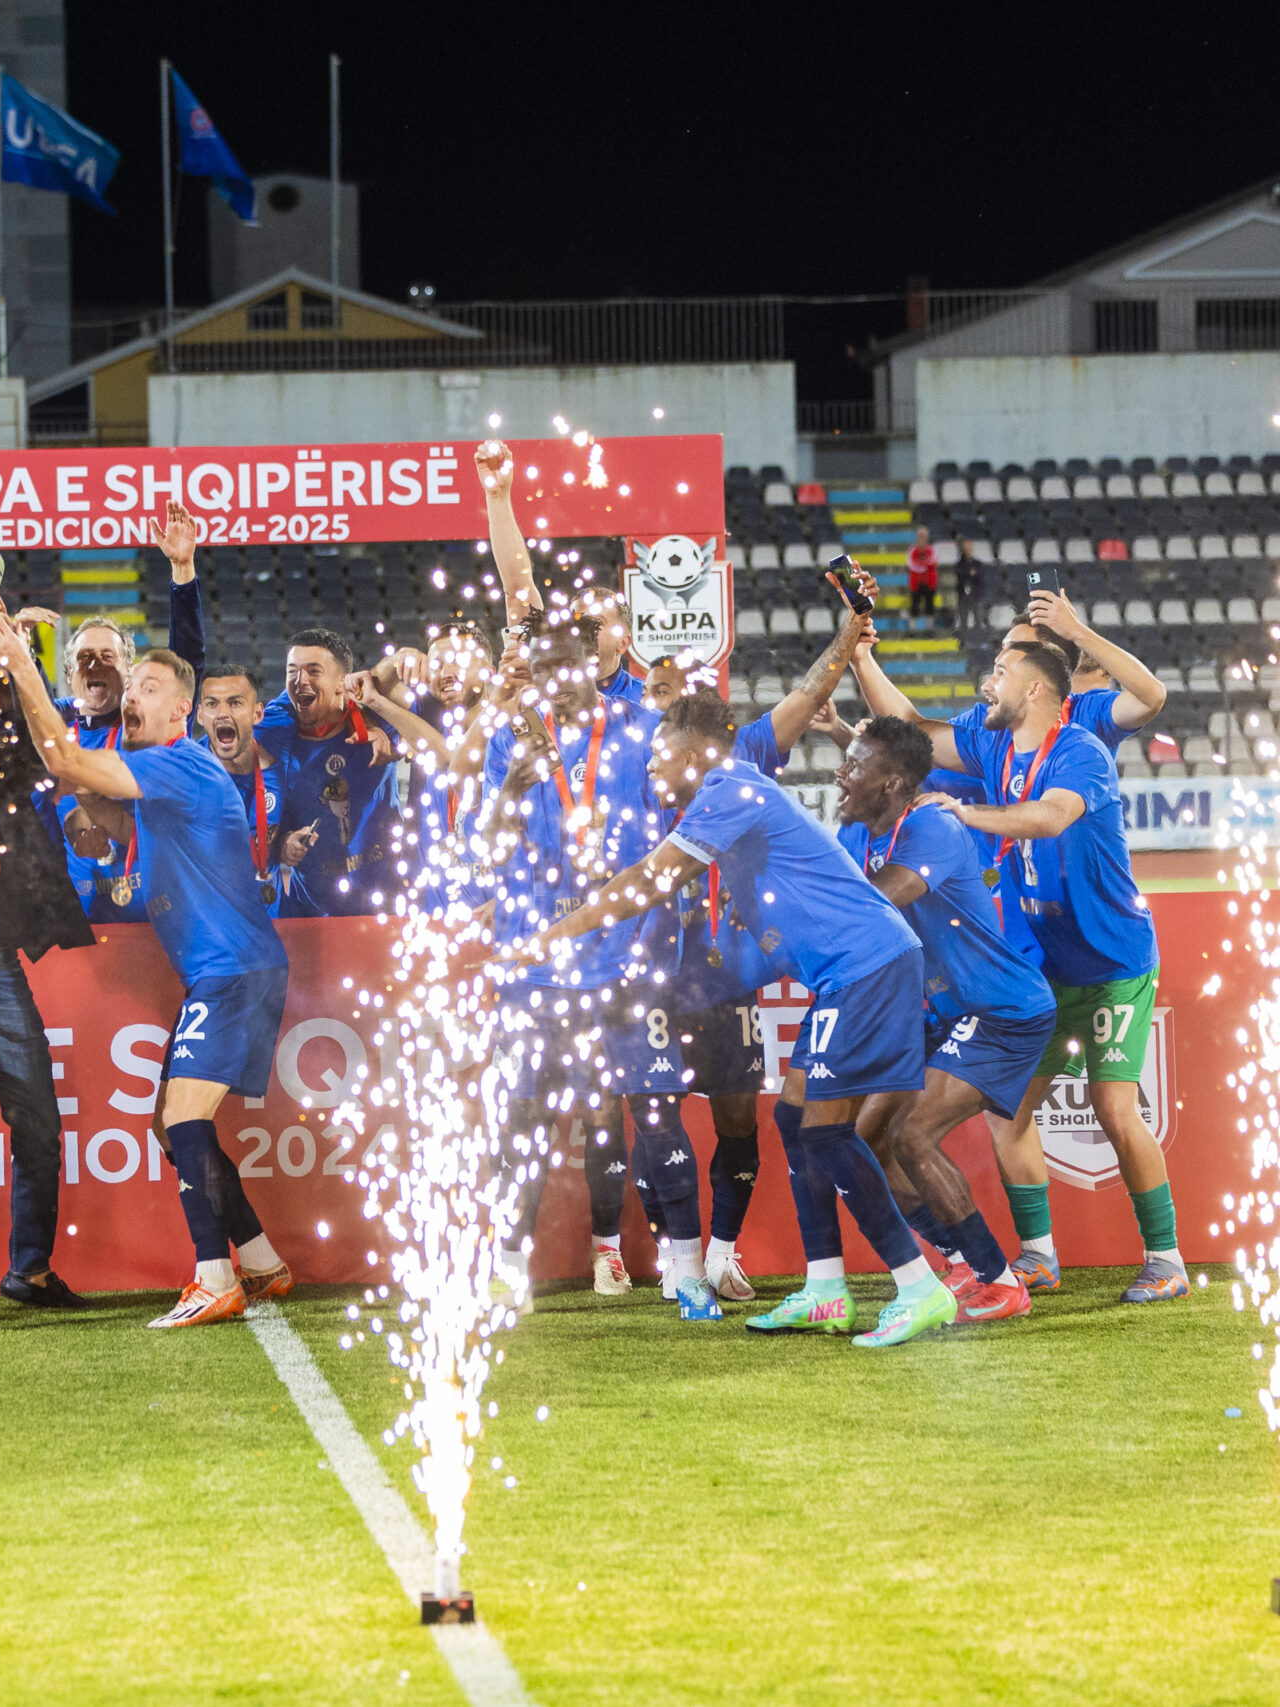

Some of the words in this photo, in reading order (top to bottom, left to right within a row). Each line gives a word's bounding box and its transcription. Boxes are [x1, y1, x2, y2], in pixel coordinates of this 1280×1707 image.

[56, 466, 90, 512] E
[103, 446, 460, 512] SHQIPËRISË
[195, 514, 350, 543] 024-2025
[637, 612, 715, 631] KUPA
[174, 1002, 209, 1042] 22
[646, 1008, 669, 1049] 8
[735, 1005, 764, 1047] 18
[810, 1008, 839, 1054] 17
[1092, 1004, 1135, 1044] 97
